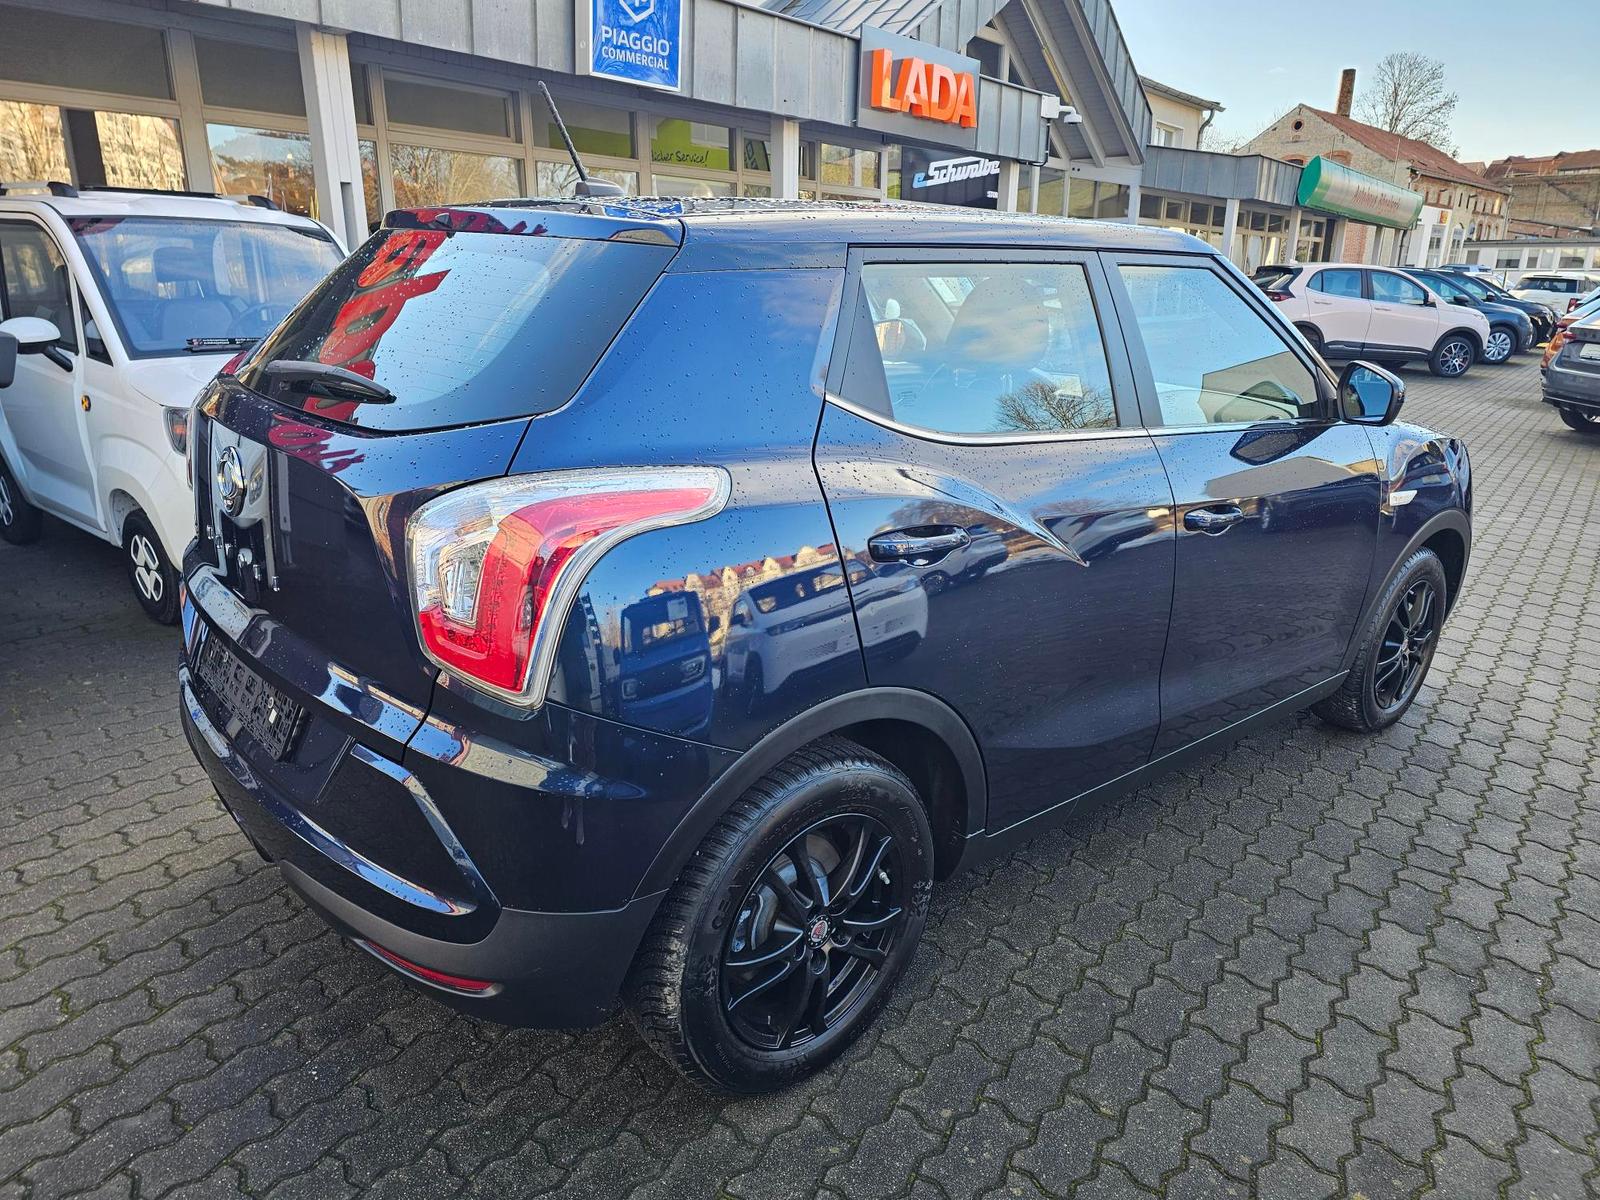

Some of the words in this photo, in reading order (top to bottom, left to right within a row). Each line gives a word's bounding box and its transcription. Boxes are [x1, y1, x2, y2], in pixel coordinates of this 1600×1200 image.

[601, 25, 670, 56] PIAGGIO
[601, 45, 669, 70] COMMERCIAL
[871, 48, 977, 128] LADA
